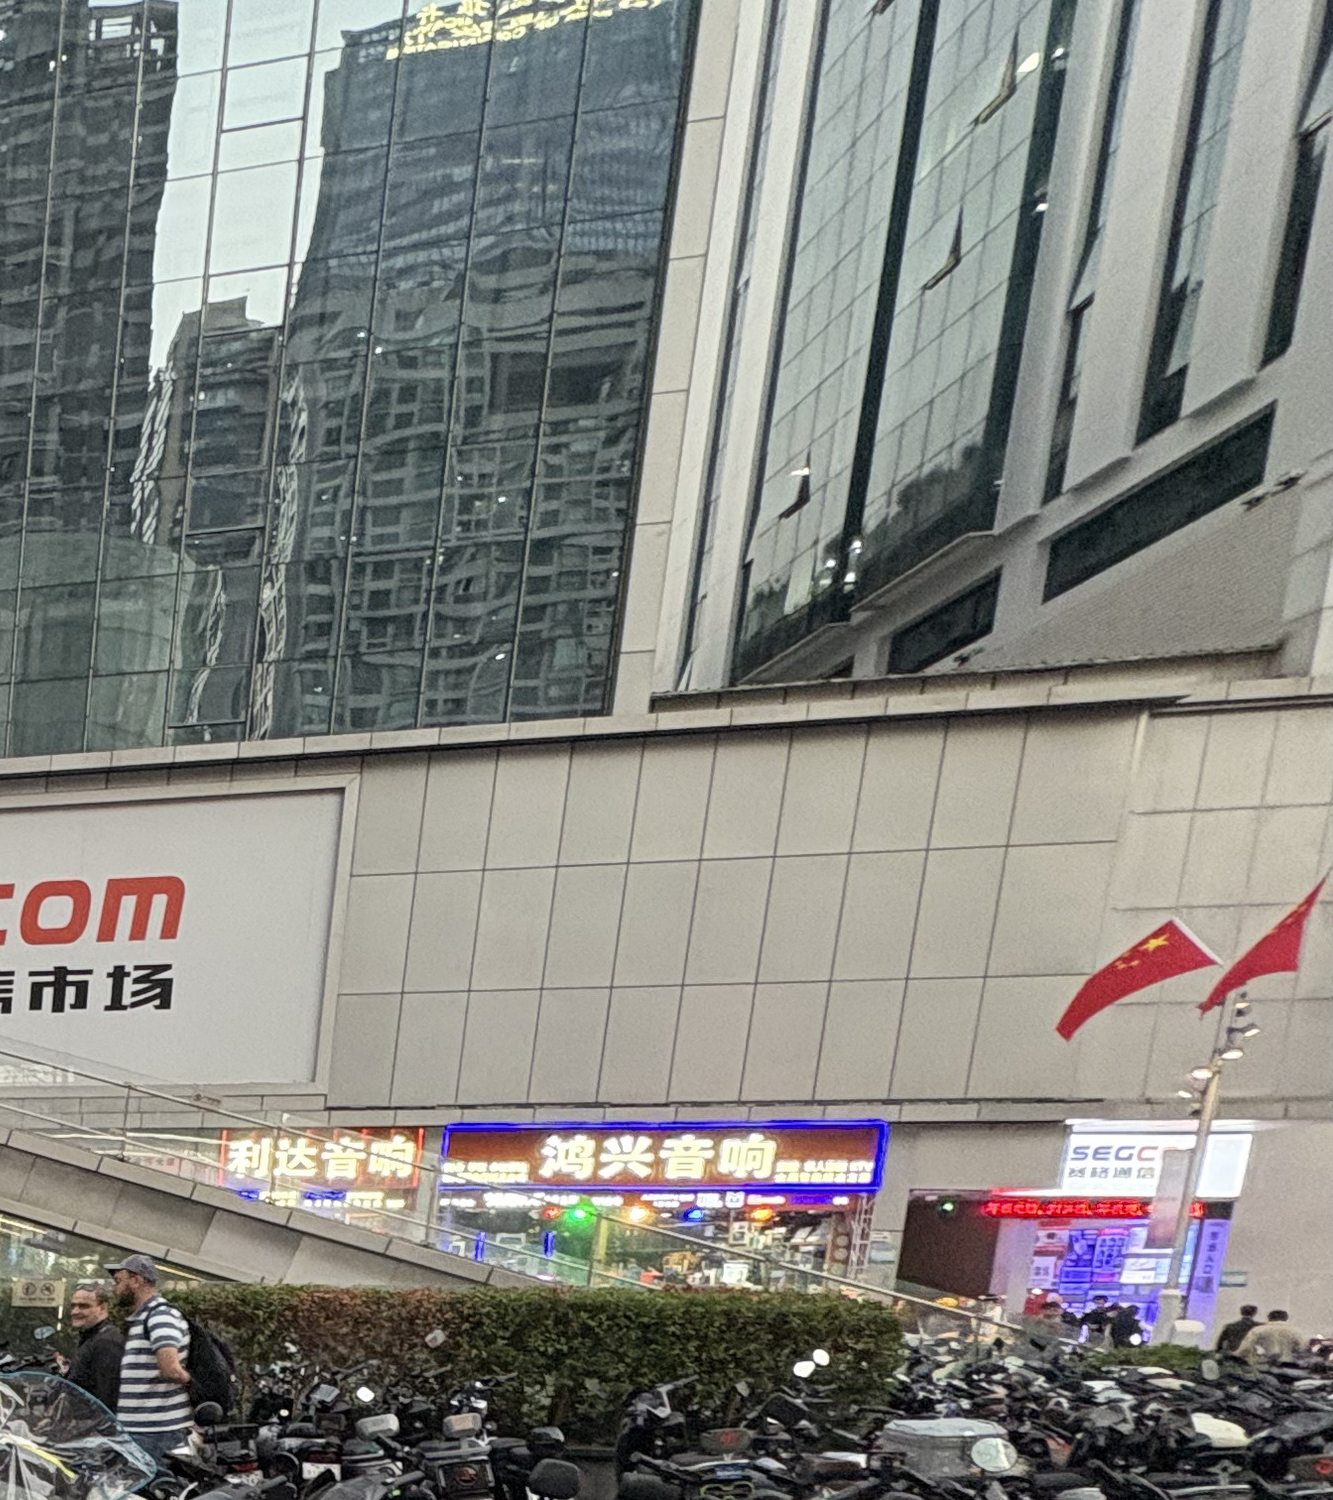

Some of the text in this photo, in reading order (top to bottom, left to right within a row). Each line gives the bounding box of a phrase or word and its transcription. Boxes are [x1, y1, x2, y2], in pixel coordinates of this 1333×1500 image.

[227, 1135, 415, 1178] 利达音响
[538, 1133, 777, 1179] 鸿兴音响
[1070, 1146, 1181, 1161] SEGC
